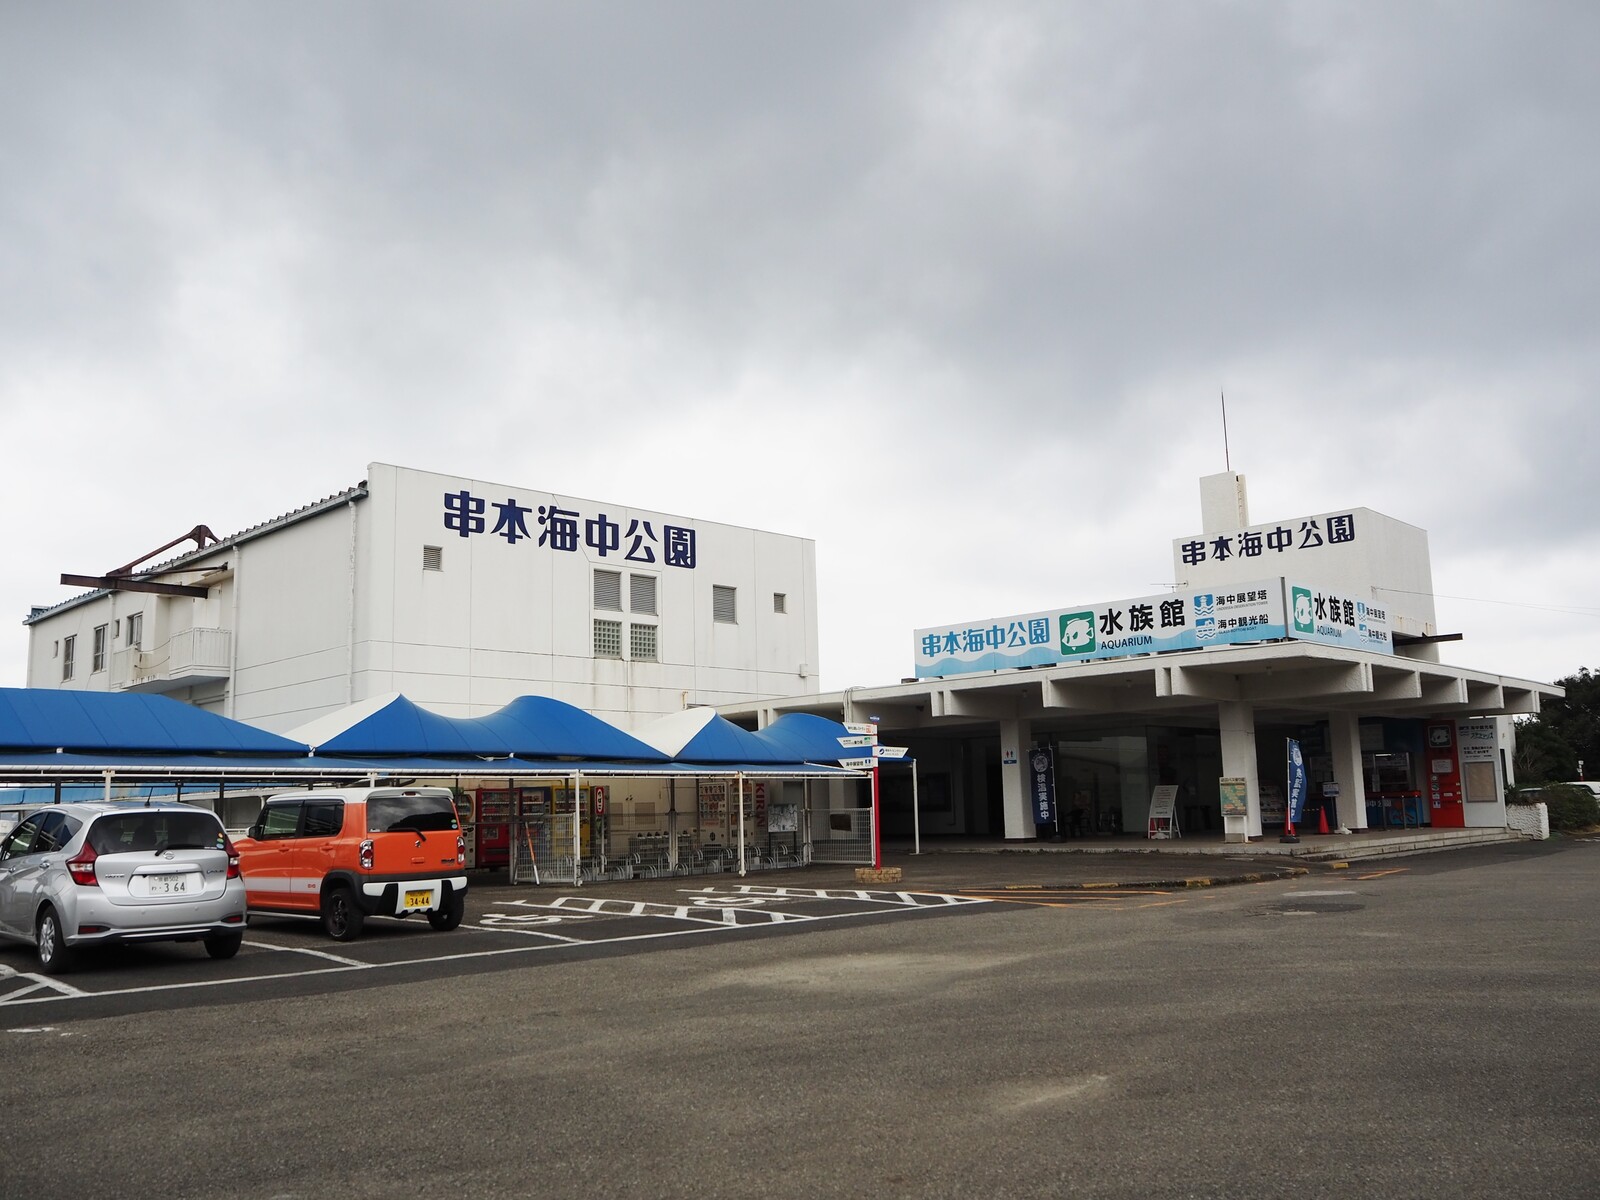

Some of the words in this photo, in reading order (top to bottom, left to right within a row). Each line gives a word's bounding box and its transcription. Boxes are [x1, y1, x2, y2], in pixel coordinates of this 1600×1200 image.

[444, 490, 696, 569] 串本海中公園
[1181, 514, 1355, 566] 串本海中公園
[1216, 589, 1267, 606] 海中展望塔
[1314, 592, 1355, 628] 水族館
[1099, 599, 1186, 636] 水族館
[1217, 614, 1268, 629] 海中観光船
[1317, 625, 1342, 638] AQUARIUM
[922, 617, 1050, 658] 串本海中公園
[1100, 635, 1153, 650] AQUARIUM
[755, 783, 765, 827] KIRIN
